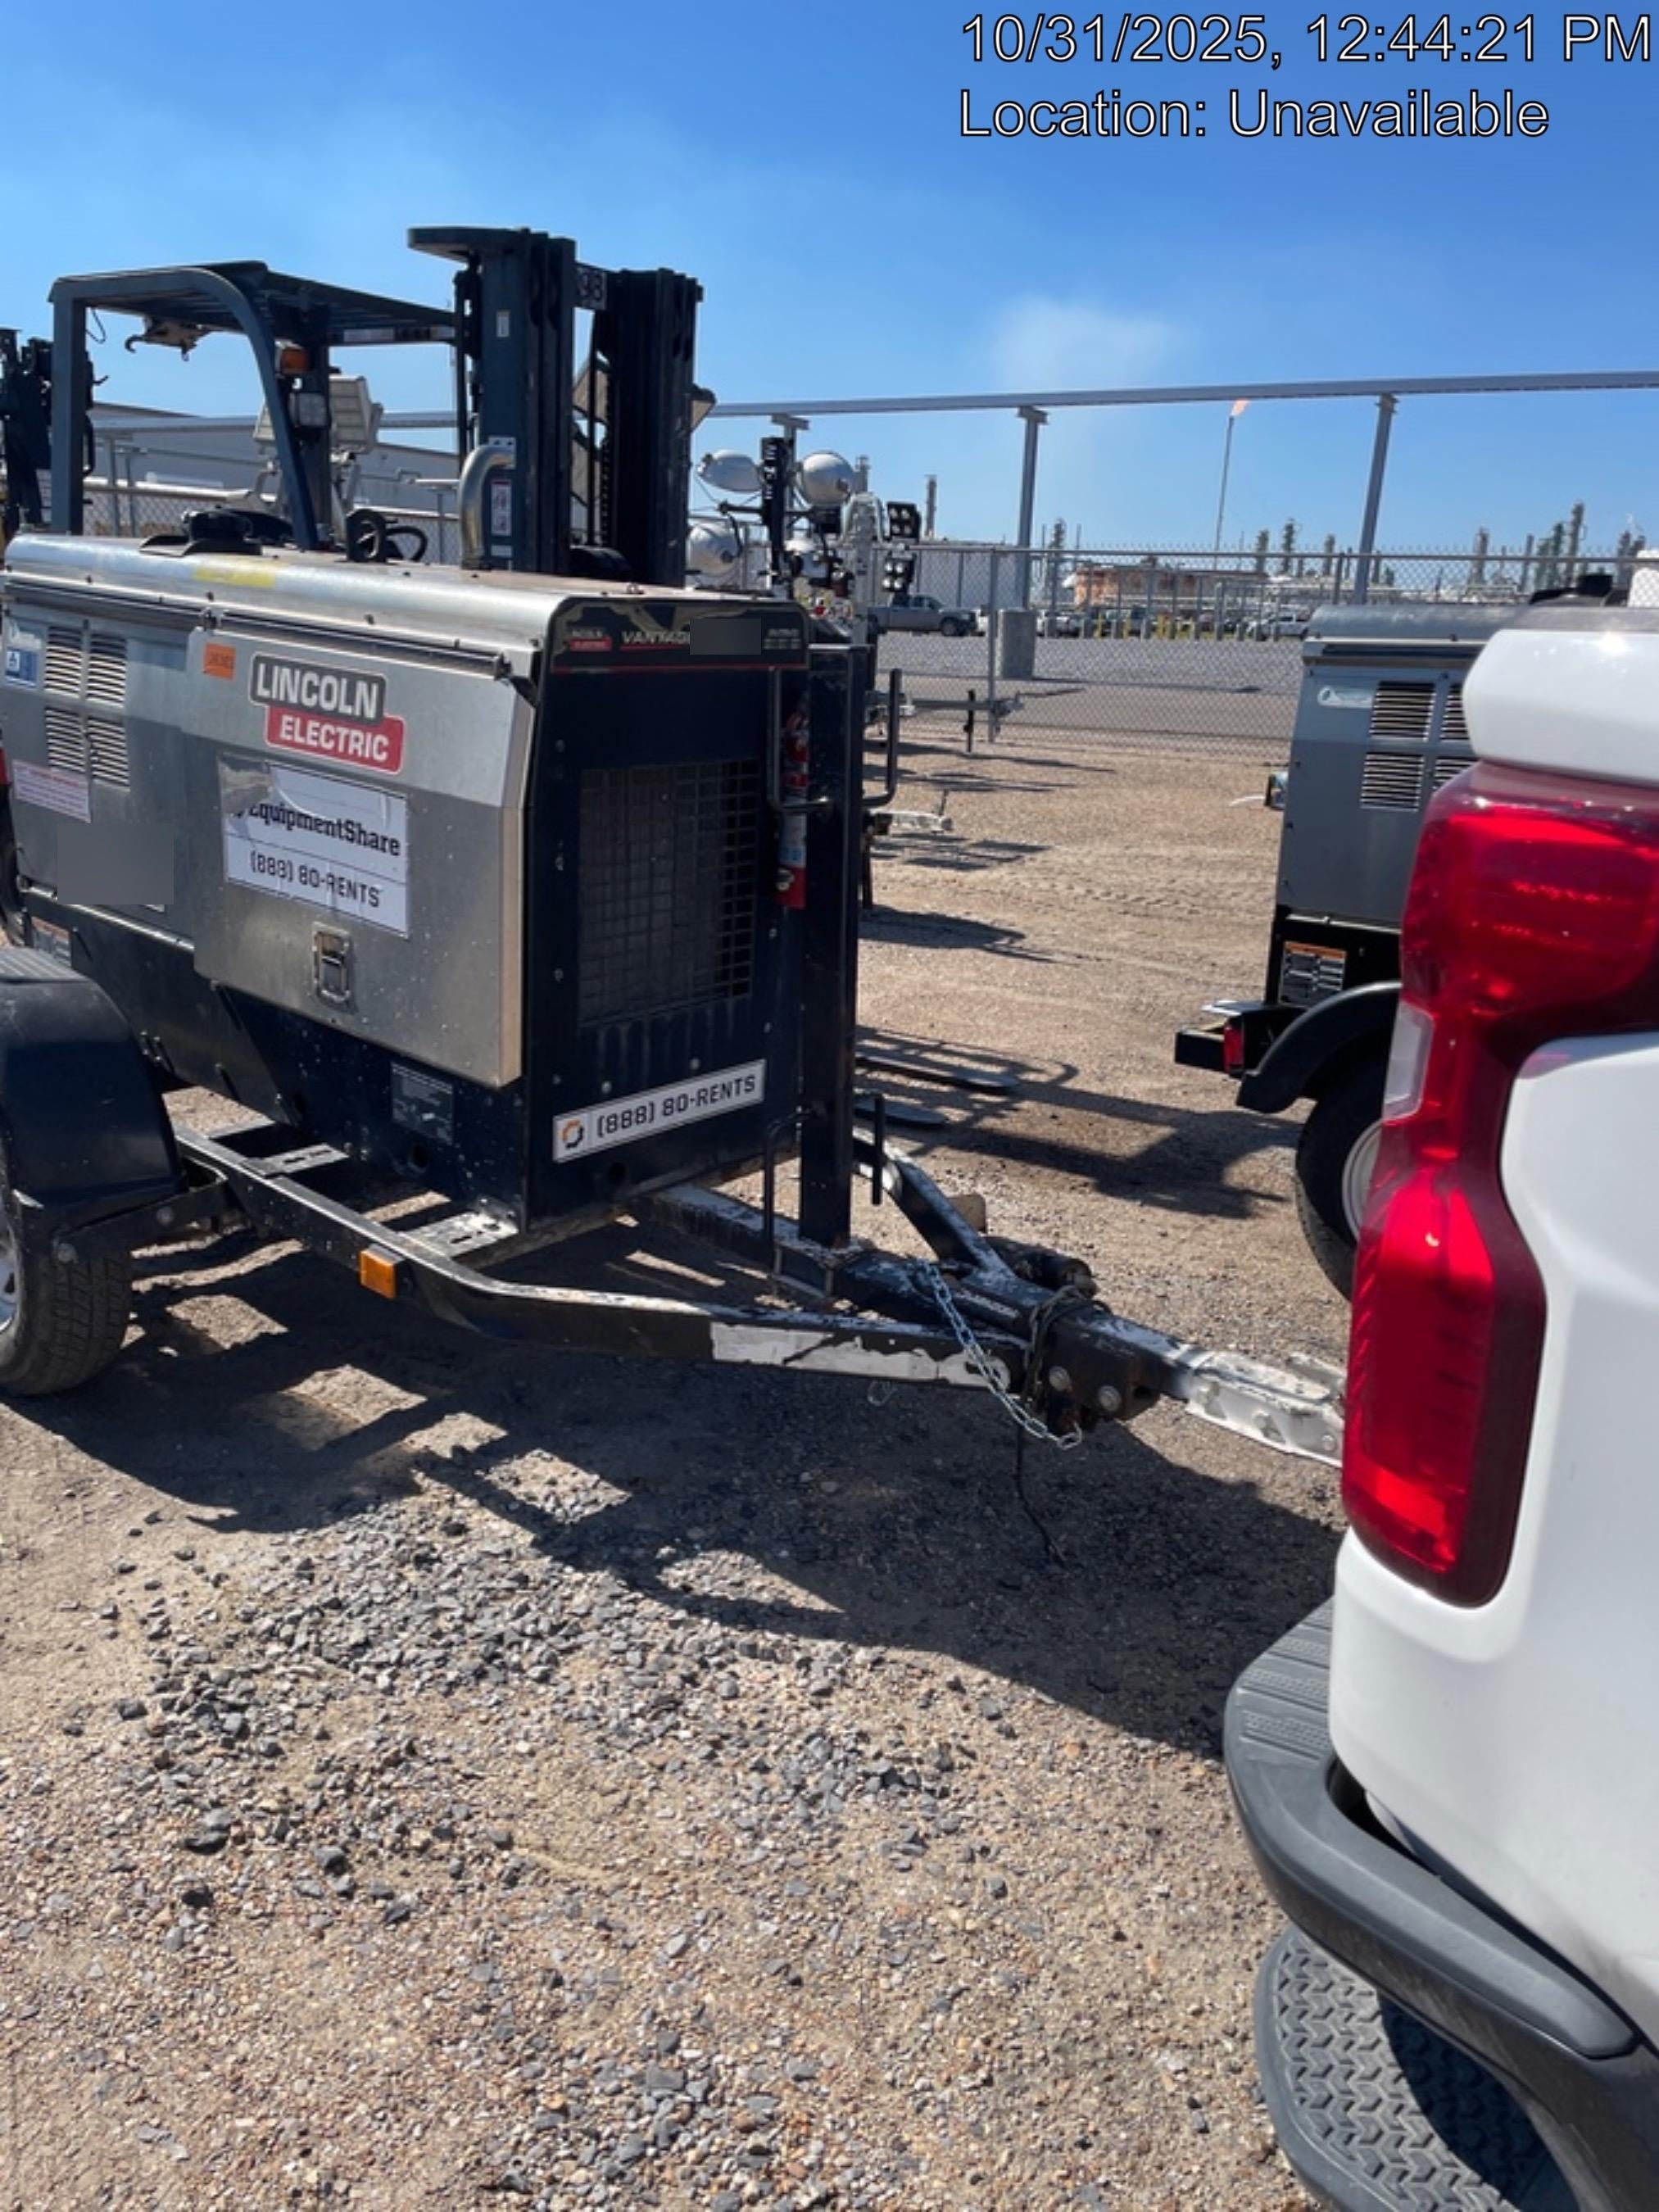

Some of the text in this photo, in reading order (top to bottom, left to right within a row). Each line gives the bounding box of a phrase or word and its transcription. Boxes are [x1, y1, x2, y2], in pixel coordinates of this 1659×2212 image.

[256, 663, 379, 719] LINCOLN
[279, 714, 389, 763] ELECTRIC
[250, 850, 380, 908] (888) 80-RENTS
[596, 1074, 756, 1138] (888) 80-RENTS
